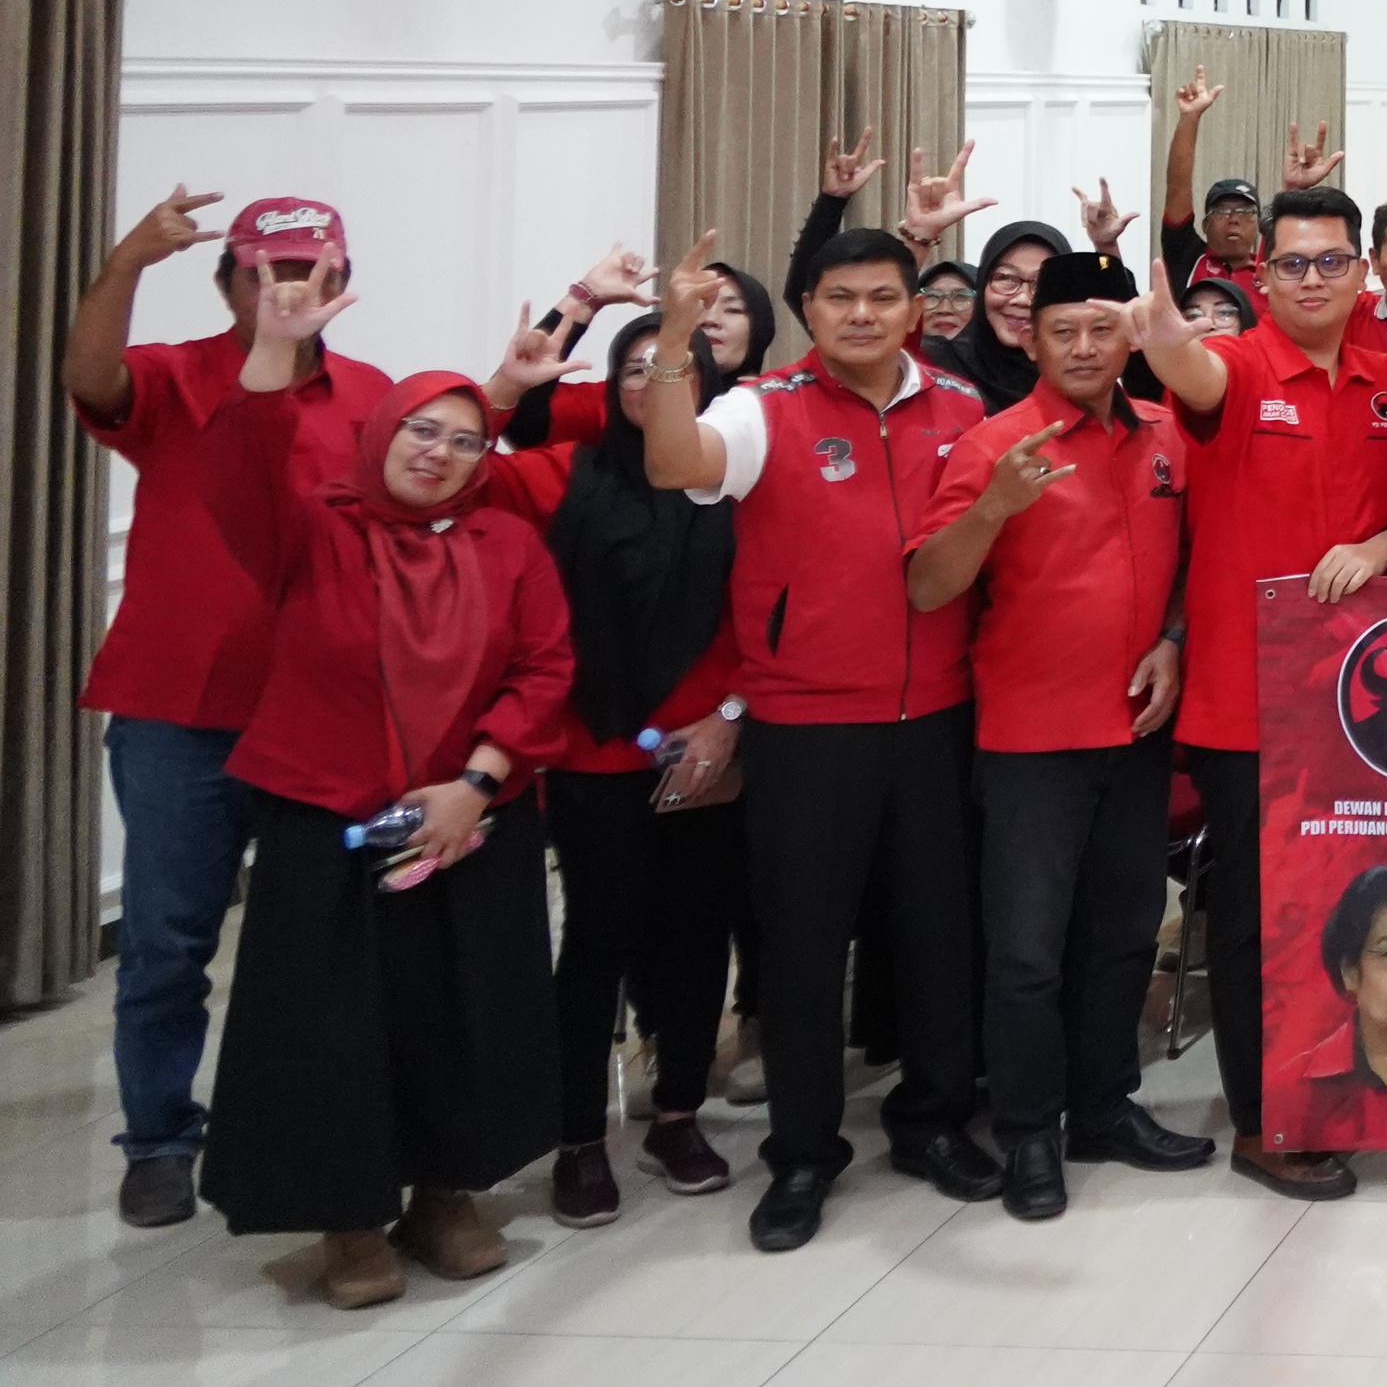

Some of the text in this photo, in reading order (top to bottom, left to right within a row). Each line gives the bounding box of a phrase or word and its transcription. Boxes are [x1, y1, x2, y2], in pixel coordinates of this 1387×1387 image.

[814, 437, 858, 482] 3
[1334, 800, 1382, 816] DEWAN
[1301, 820, 1326, 836] PDI
